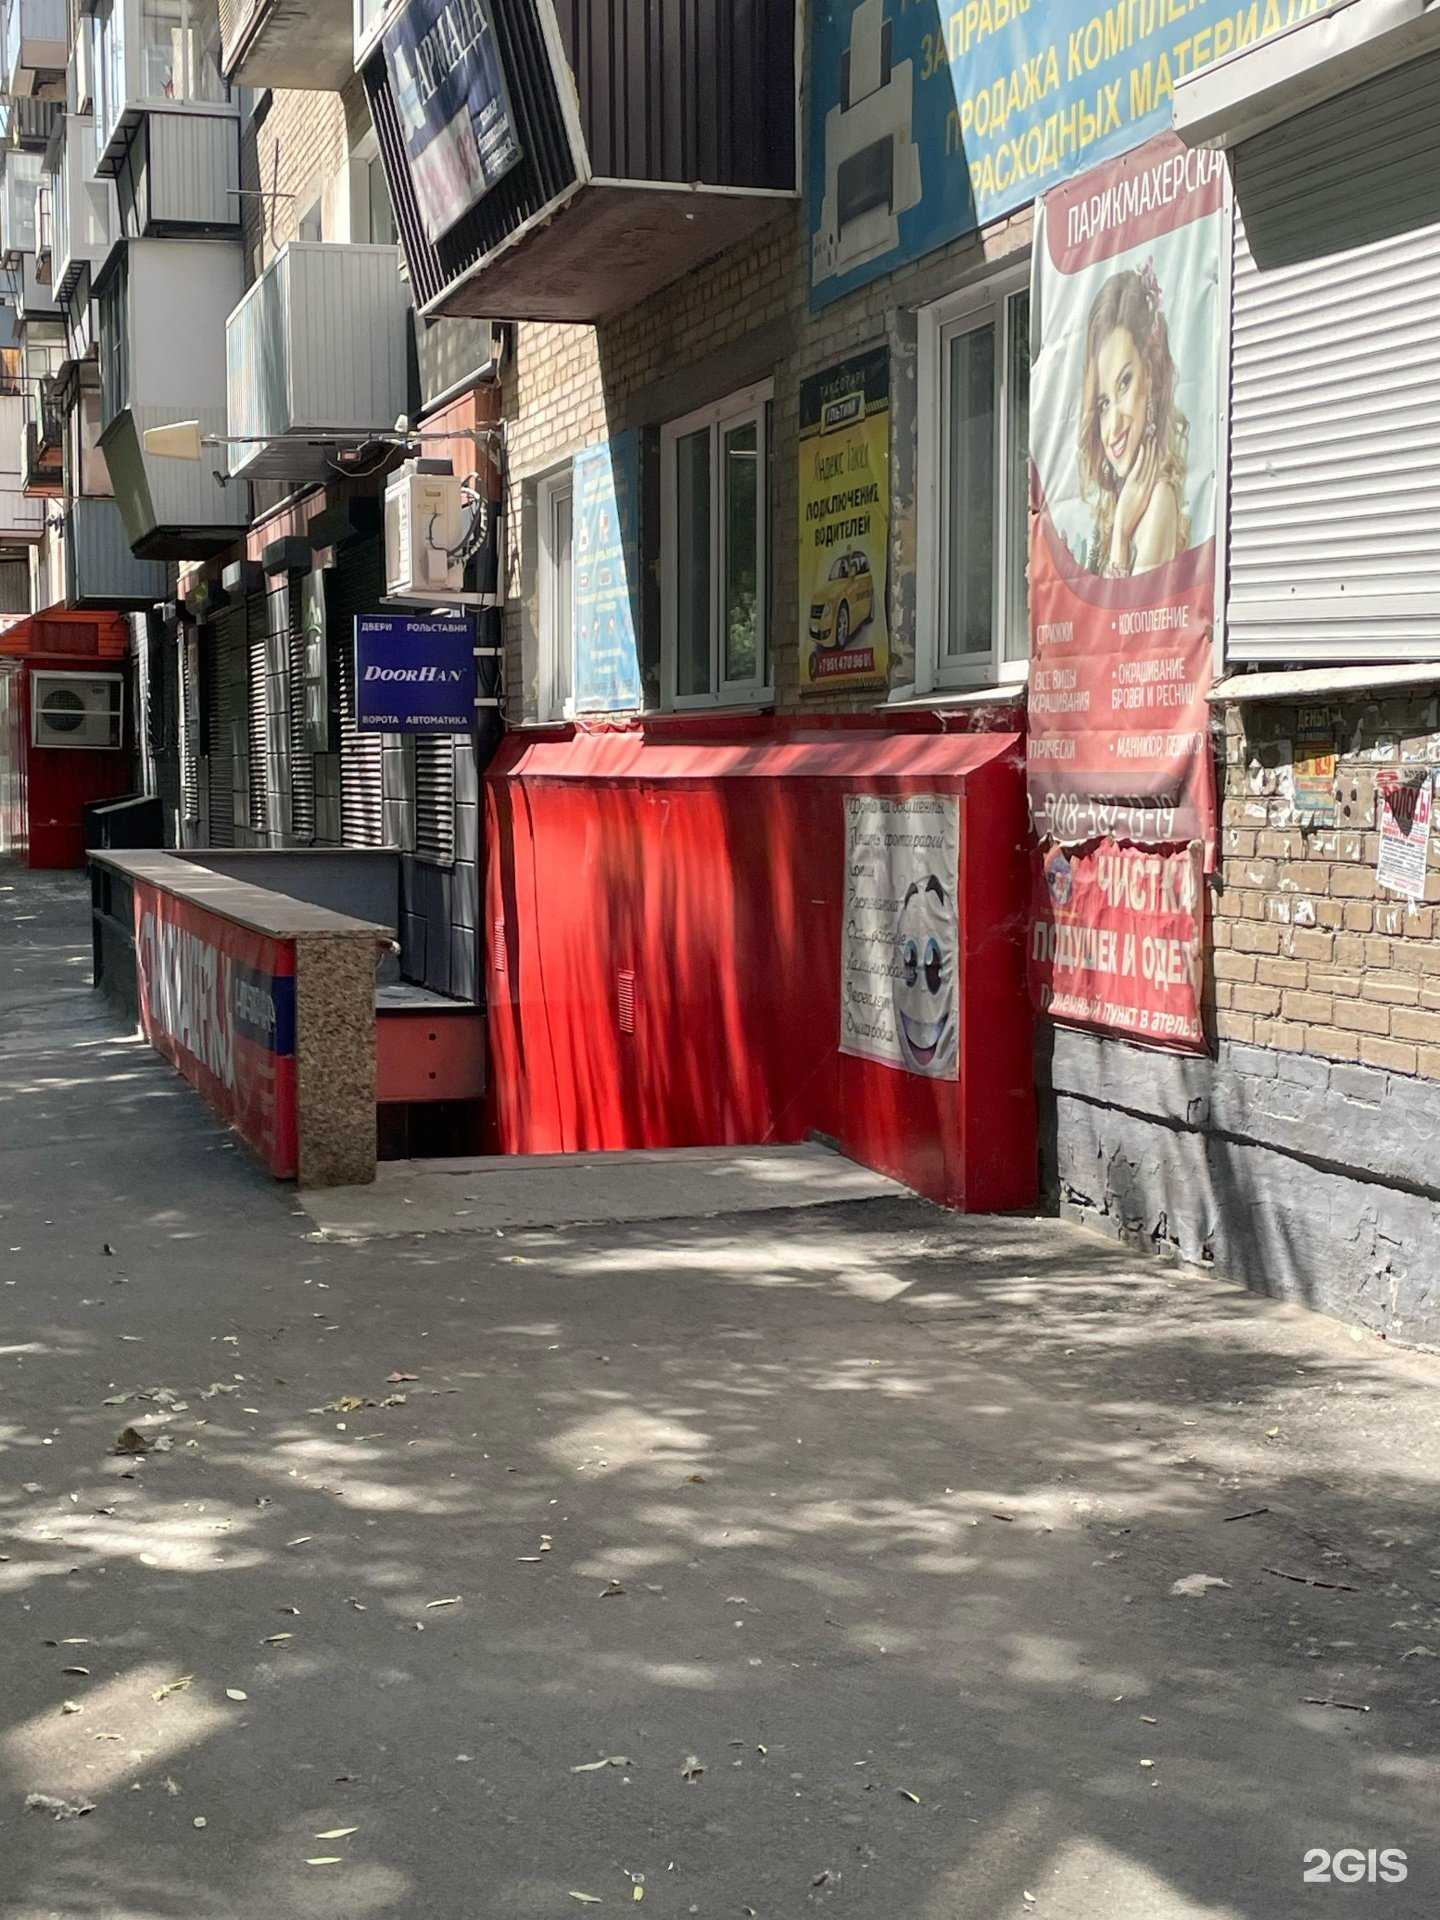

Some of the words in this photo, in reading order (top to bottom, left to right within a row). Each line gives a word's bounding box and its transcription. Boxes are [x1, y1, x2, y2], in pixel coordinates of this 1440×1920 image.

[945, 45, 1060, 157] ПРОДАЖА
[1067, 0, 1206, 82] КОМПЛЕ
[968, 79, 1122, 201] РАСХОДНЫХ
[806, 482, 880, 522] ПОДКЛЮЧЕНИЕ
[814, 512, 871, 548] ВОДИТЕЛЕЙ
[361, 622, 393, 632] ДВЕРИ
[406, 623, 468, 633] РОЛЬСТАВНИ
[1036, 621, 1074, 646] СТРИЖКИ
[1118, 605, 1189, 635] КОСОПЛЕТЕНИЕ
[1034, 670, 1051, 691] ВСЕ
[1052, 669, 1077, 689] ВИДЫ
[1118, 657, 1186, 685] ОКРАШИВАНИЕ
[1111, 685, 1144, 710] БРОВЕЙ
[1146, 685, 1154, 707] И
[362, 715, 399, 725] ВОРОТА
[405, 716, 468, 725] АВТОМАТИКА
[1029, 739, 1076, 760] ПРИЧЕСКИ
[1098, 855, 1199, 914] ЧИСТКА
[1032, 921, 1118, 975] ПОДУШЕК
[1121, 932, 1136, 977] И
[1102, 1001, 1137, 1025] пункт
